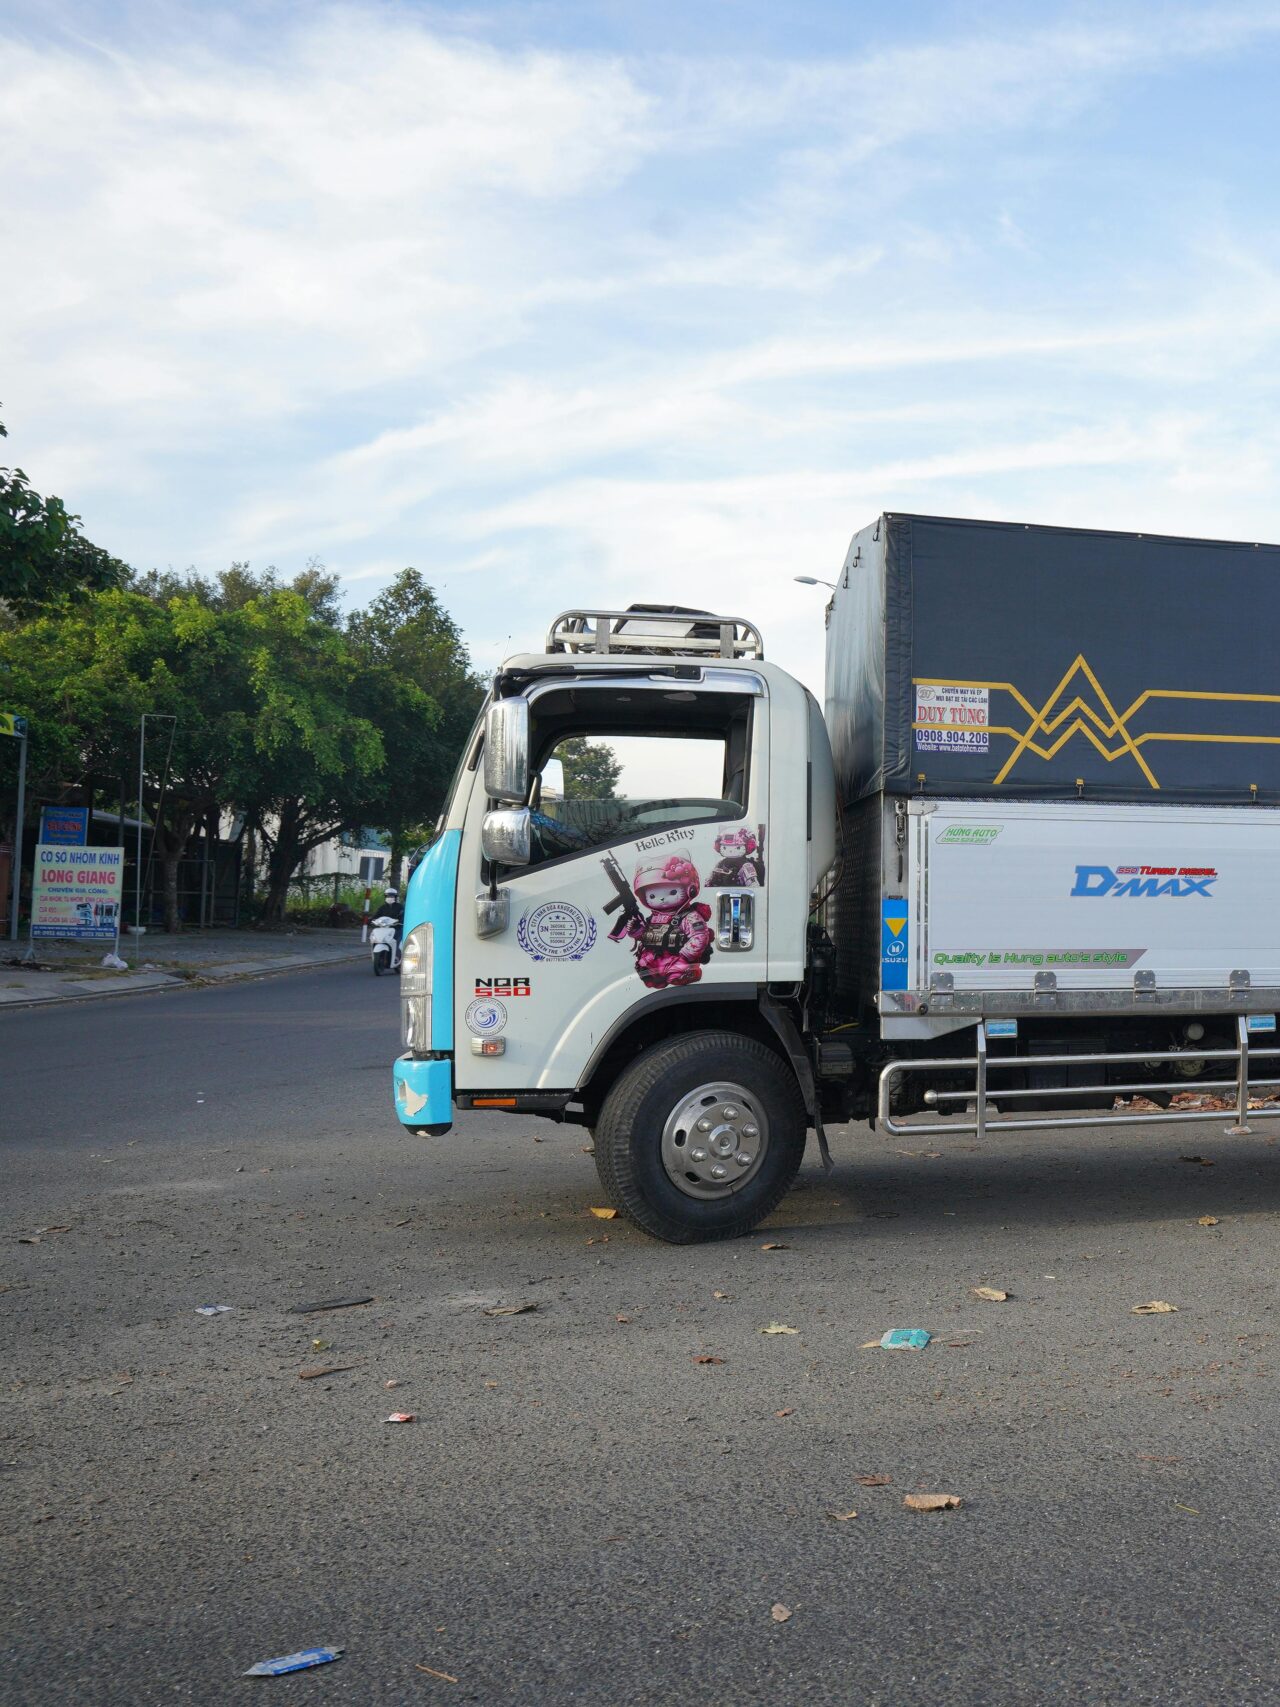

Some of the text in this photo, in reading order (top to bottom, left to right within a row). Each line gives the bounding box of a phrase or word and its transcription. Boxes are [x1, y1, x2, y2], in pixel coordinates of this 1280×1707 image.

[917, 704, 986, 724] DUY TÙNG
[917, 730, 988, 744] 0908.904.206
[917, 743, 939, 751] Website:
[972, 829, 998, 837] AUTO
[635, 829, 695, 852] Hello Kitty
[42, 869, 116, 885] LONG GIANG
[540, 925, 549, 933] 3N
[933, 952, 1128, 967] Quality is Hung auto's style
[475, 977, 531, 987] NQR
[475, 986, 531, 997] 550
